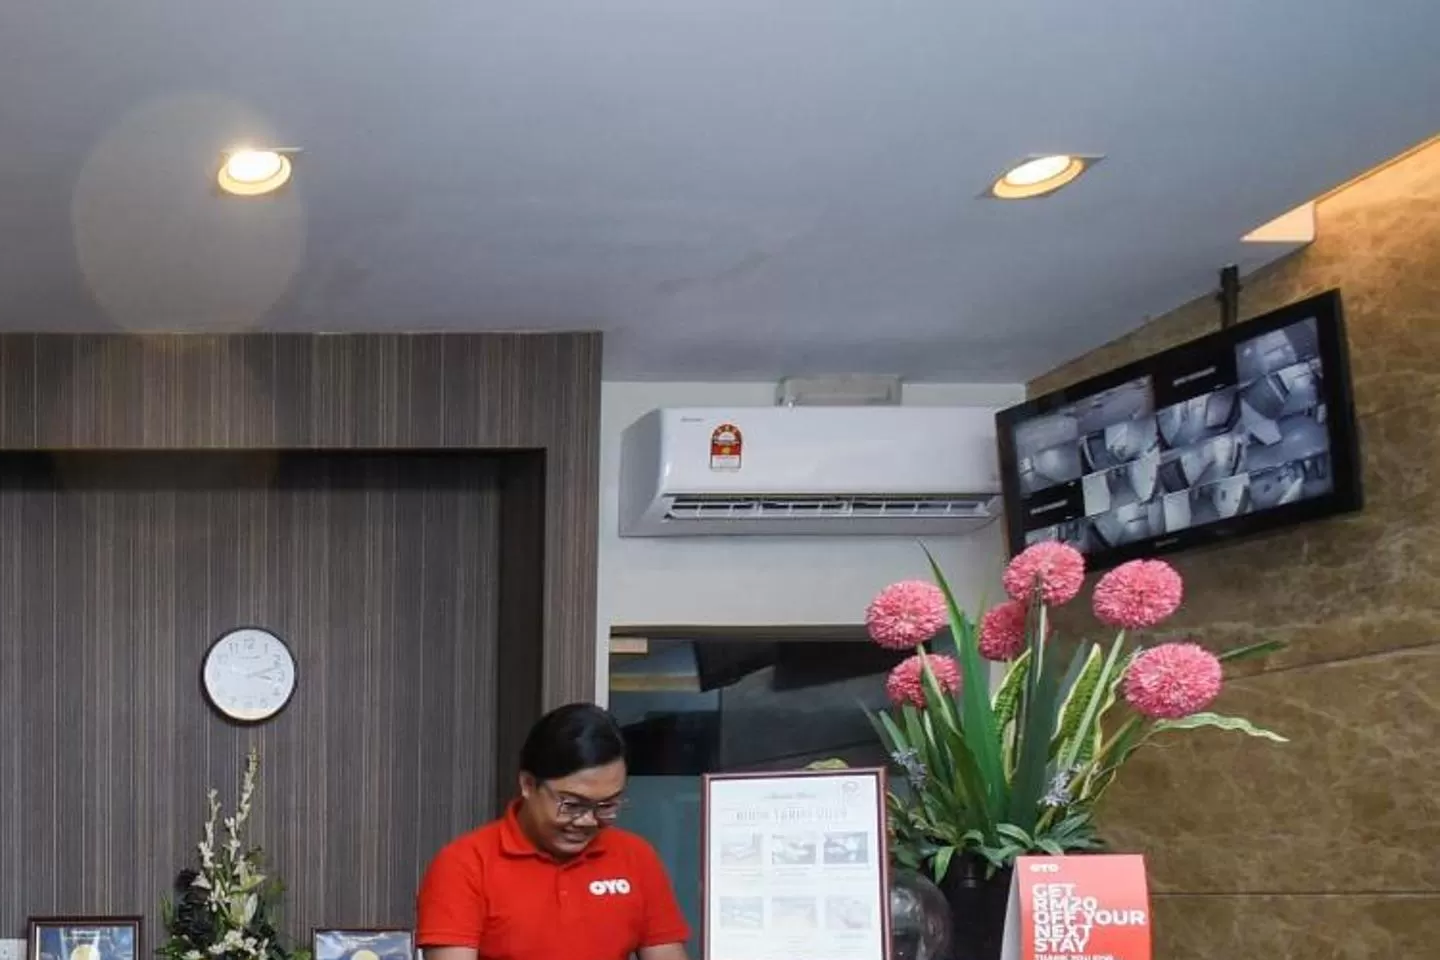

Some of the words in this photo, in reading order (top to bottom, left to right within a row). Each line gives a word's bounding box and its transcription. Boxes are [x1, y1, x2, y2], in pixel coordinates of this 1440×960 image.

[589, 878, 631, 896] OYO
[1032, 883, 1076, 898] GET
[1079, 909, 1147, 925] YOUR
[1034, 923, 1092, 939] NEXT
[1034, 937, 1089, 953] STAY
